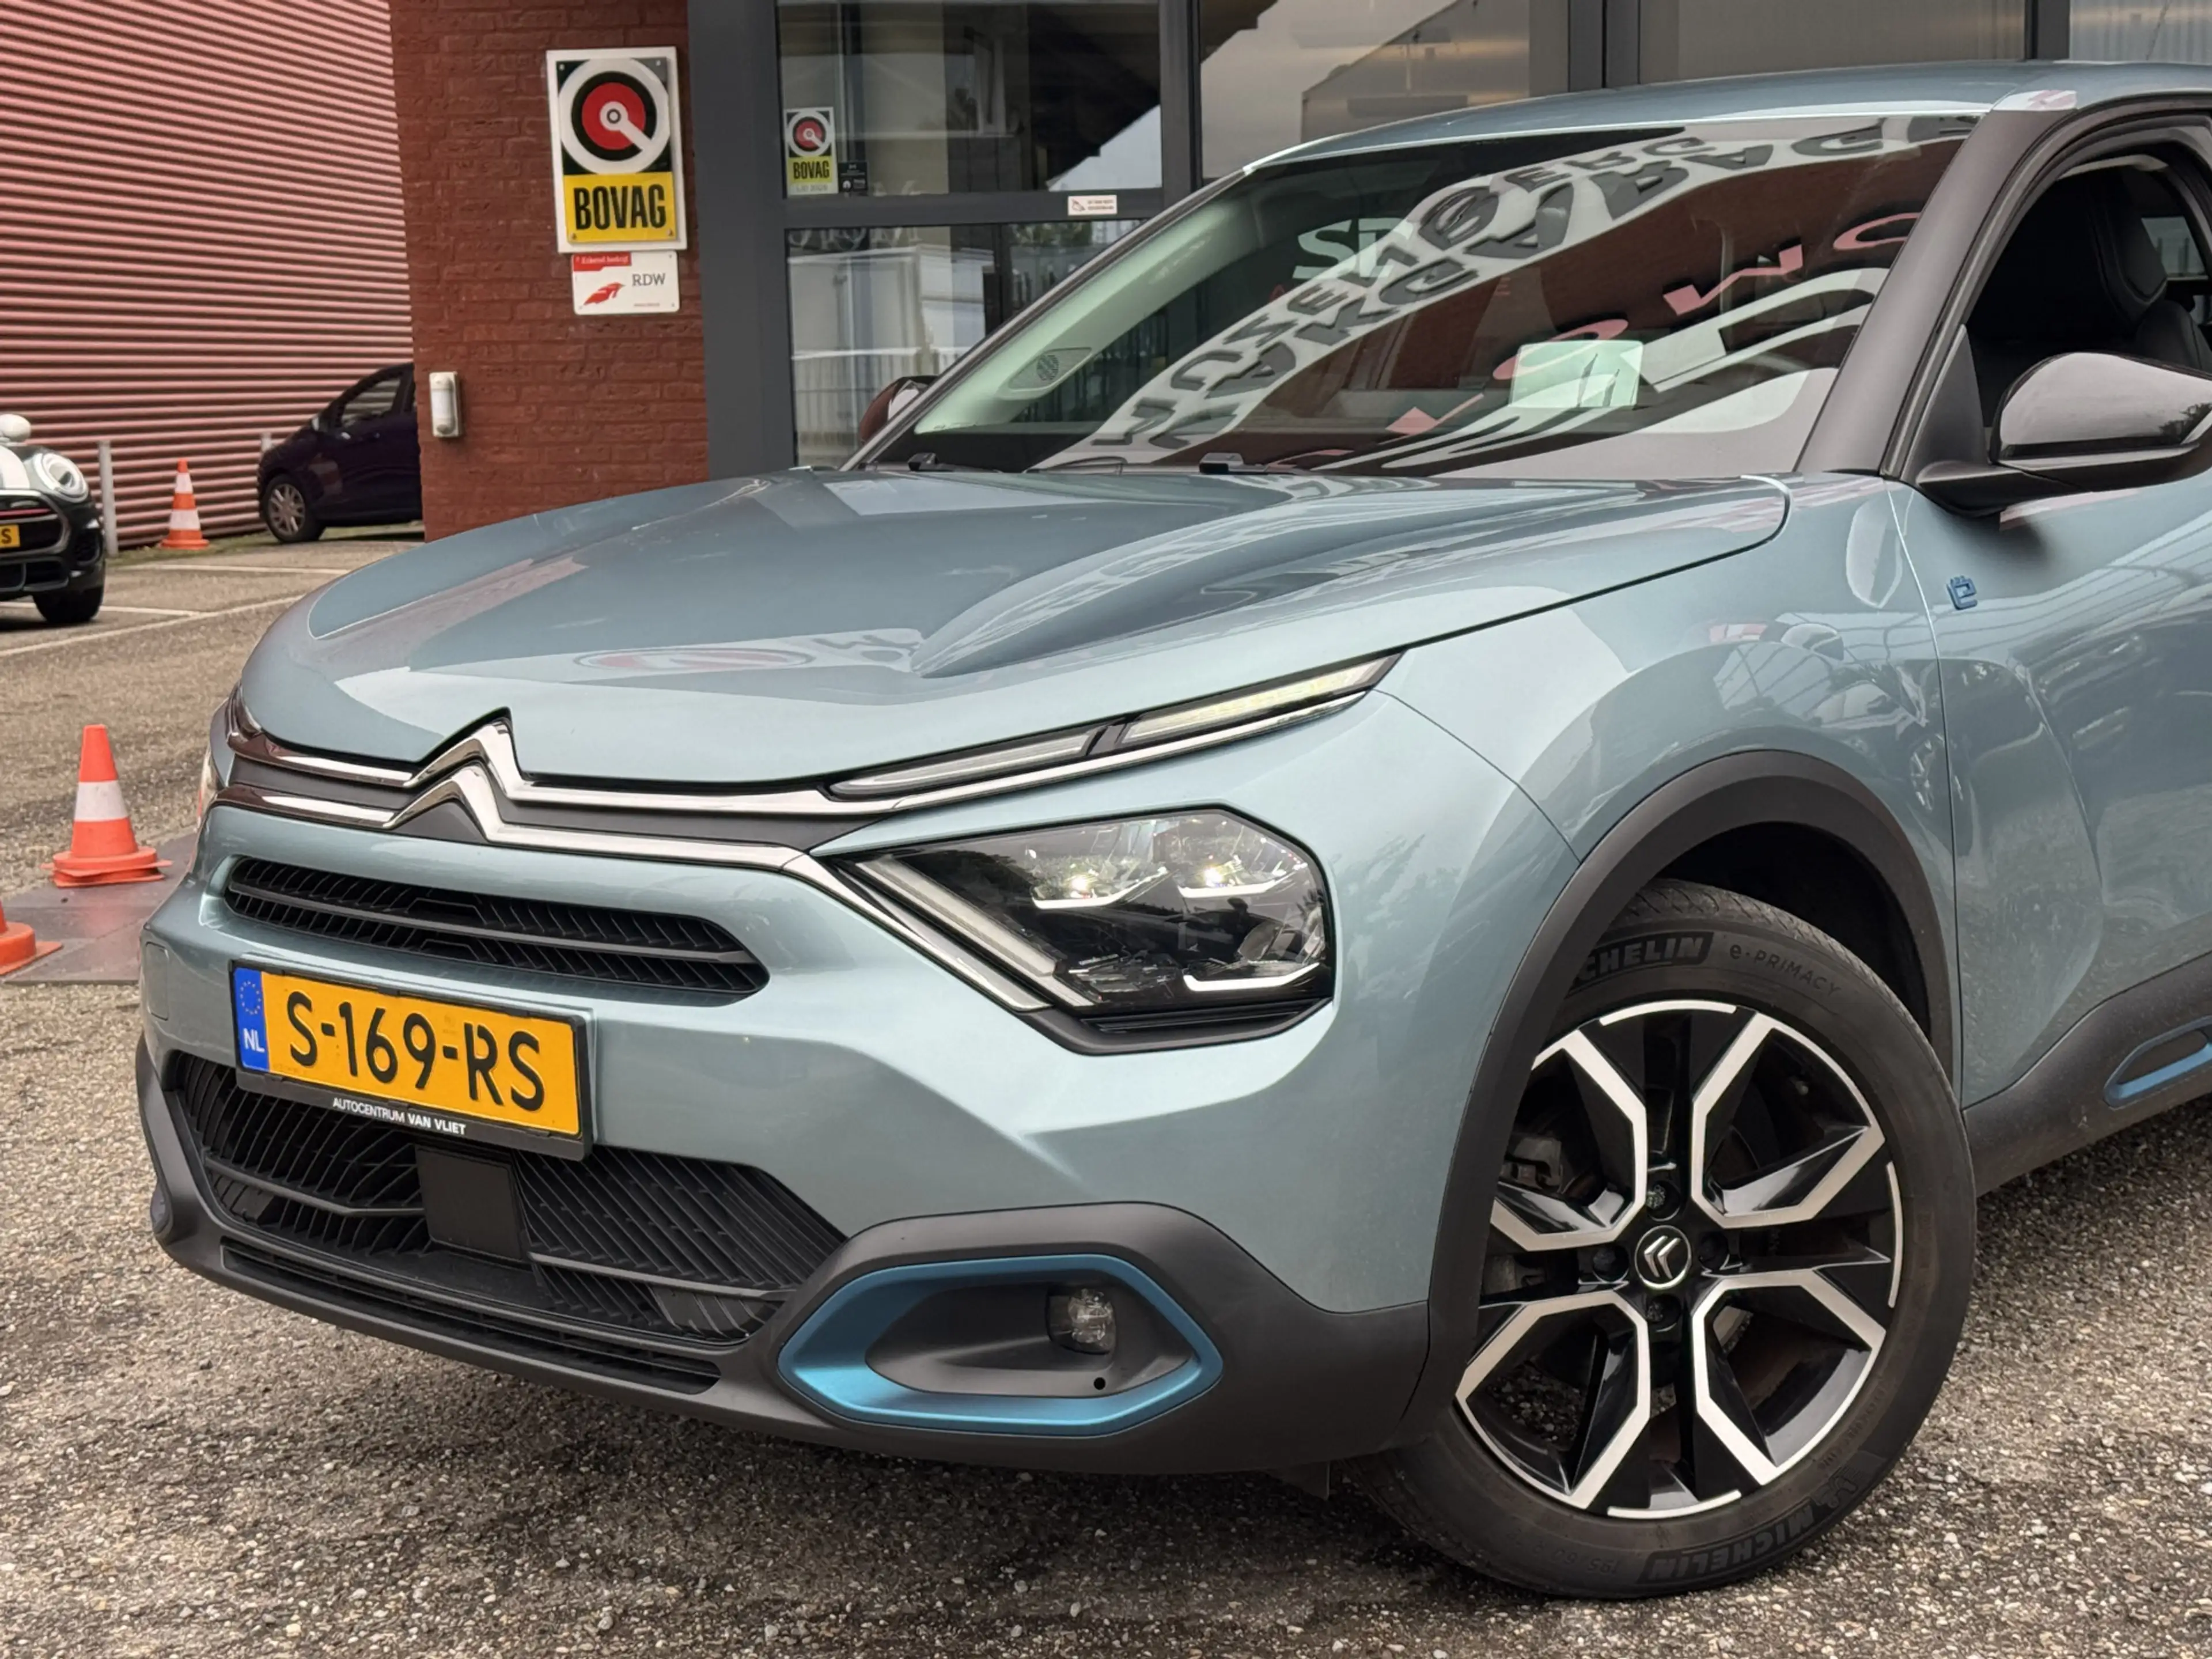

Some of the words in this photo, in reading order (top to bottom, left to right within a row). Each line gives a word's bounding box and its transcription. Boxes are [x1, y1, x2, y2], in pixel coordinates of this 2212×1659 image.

[793, 160, 830, 180] BOVAG
[573, 183, 667, 231] BOVAG
[632, 272, 666, 286] RDW
[243, 1028, 265, 1054] NL
[287, 990, 545, 1112] S-169-RS
[332, 1097, 405, 1123] AUTOCENTRUM
[407, 1113, 431, 1128] VAN
[434, 1118, 467, 1135] VLIET
[1649, 1505, 1815, 1581] MICHELIN
